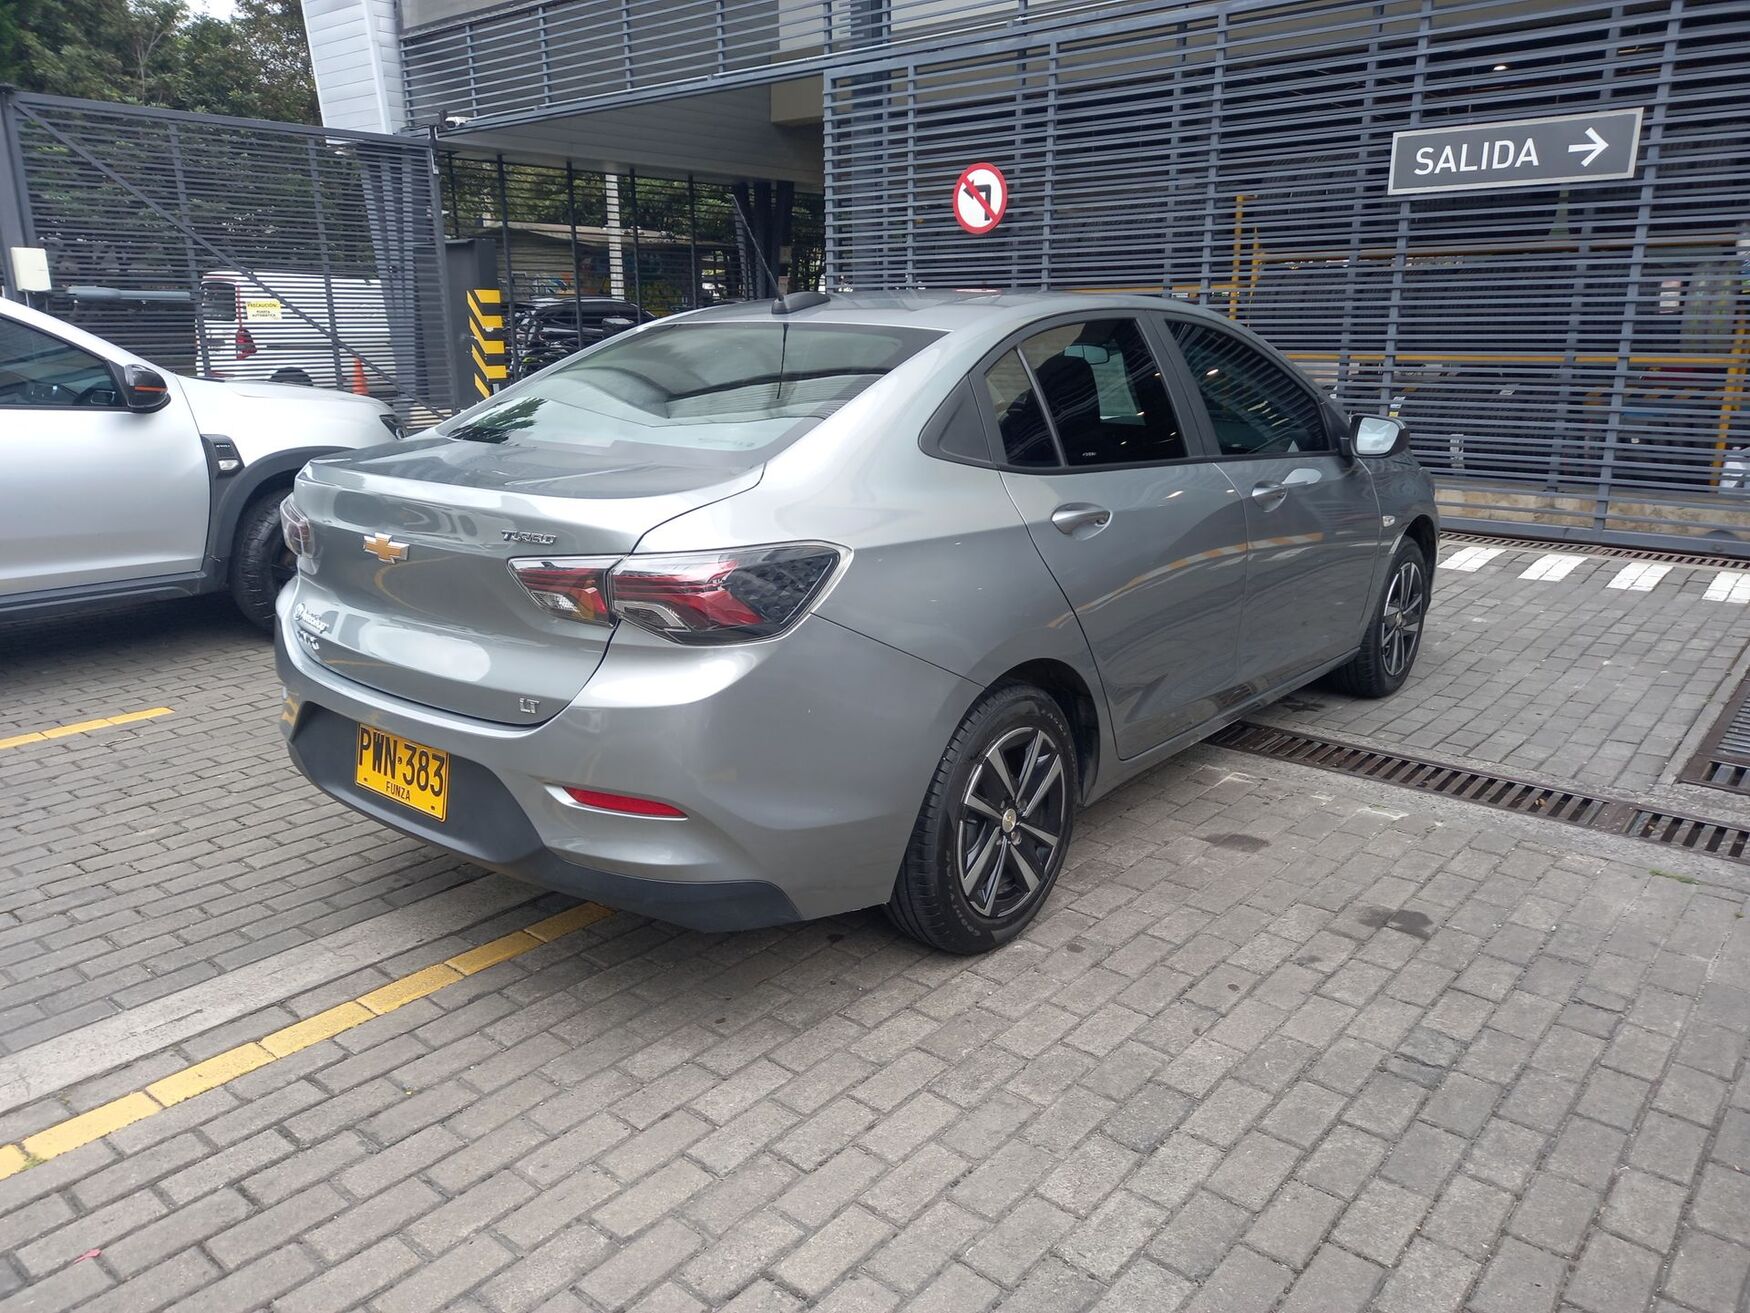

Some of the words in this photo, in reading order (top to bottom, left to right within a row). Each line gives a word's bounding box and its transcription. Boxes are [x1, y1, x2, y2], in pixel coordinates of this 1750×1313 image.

[1414, 137, 1540, 176] SALIDA
[501, 529, 556, 545] TURBO
[519, 697, 540, 714] LT
[385, 780, 411, 801] FUNZA
